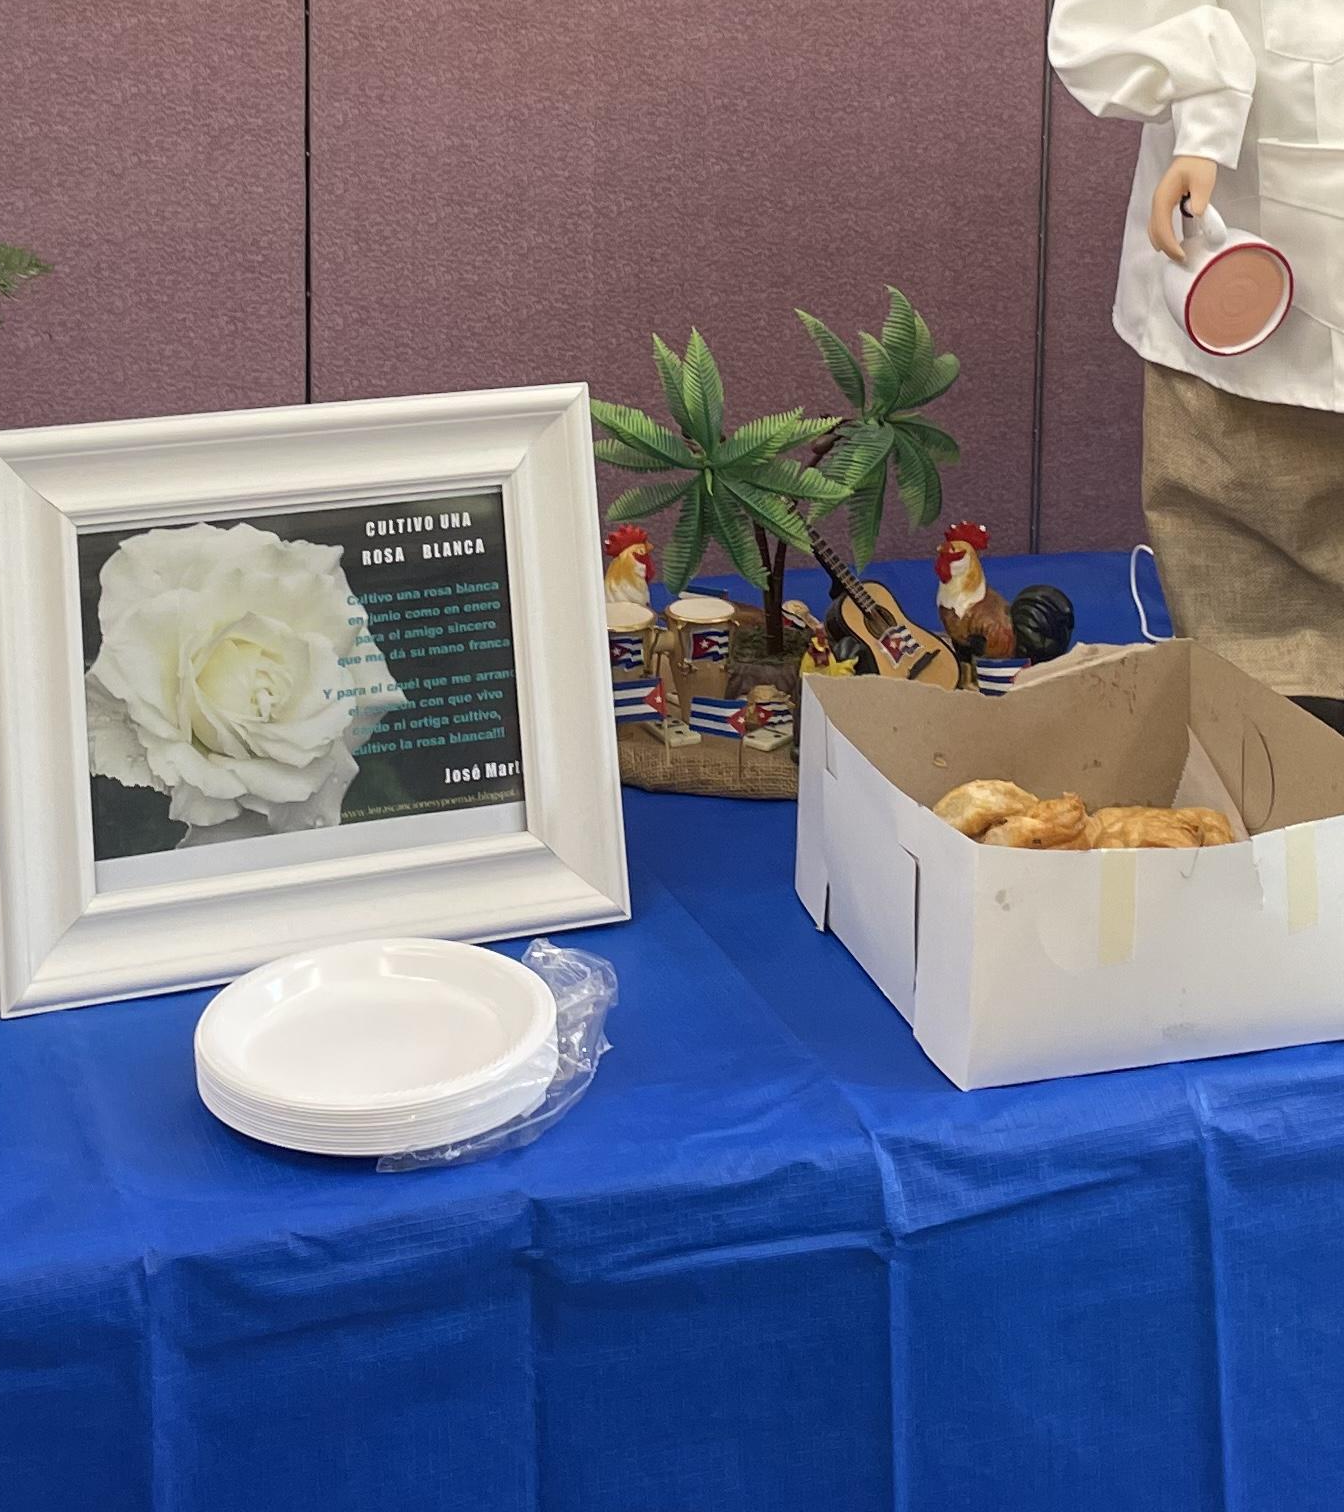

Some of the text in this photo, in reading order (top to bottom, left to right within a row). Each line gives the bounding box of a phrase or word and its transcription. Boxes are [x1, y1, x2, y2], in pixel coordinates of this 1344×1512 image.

[366, 512, 471, 536] CULTIVO UNA
[362, 538, 485, 566] ROSA BLANCA
[397, 589, 420, 600] una
[424, 586, 452, 598] rosa
[456, 580, 499, 594] blanca
[368, 612, 400, 625] junio
[406, 608, 440, 619] como
[444, 605, 459, 614] en
[464, 600, 500, 612] enero
[389, 630, 400, 640] el
[404, 625, 443, 639] amigo
[448, 621, 496, 634] sincero
[338, 656, 361, 668] que
[410, 646, 425, 657] su
[429, 641, 464, 655] mano
[469, 638, 509, 650] franca
[323, 689, 332, 699] Y
[337, 688, 366, 700] para
[371, 683, 382, 694] el
[423, 676, 448, 689] que
[452, 673, 471, 683] me
[420, 697, 443, 708] con
[448, 694, 472, 706] que
[477, 689, 503, 701] vivo
[394, 719, 405, 731] ni
[410, 715, 449, 729] ortiga
[352, 742, 396, 756] cultivo
[400, 739, 412, 750] la
[416, 735, 446, 747] rosa
[444, 764, 481, 784] José
